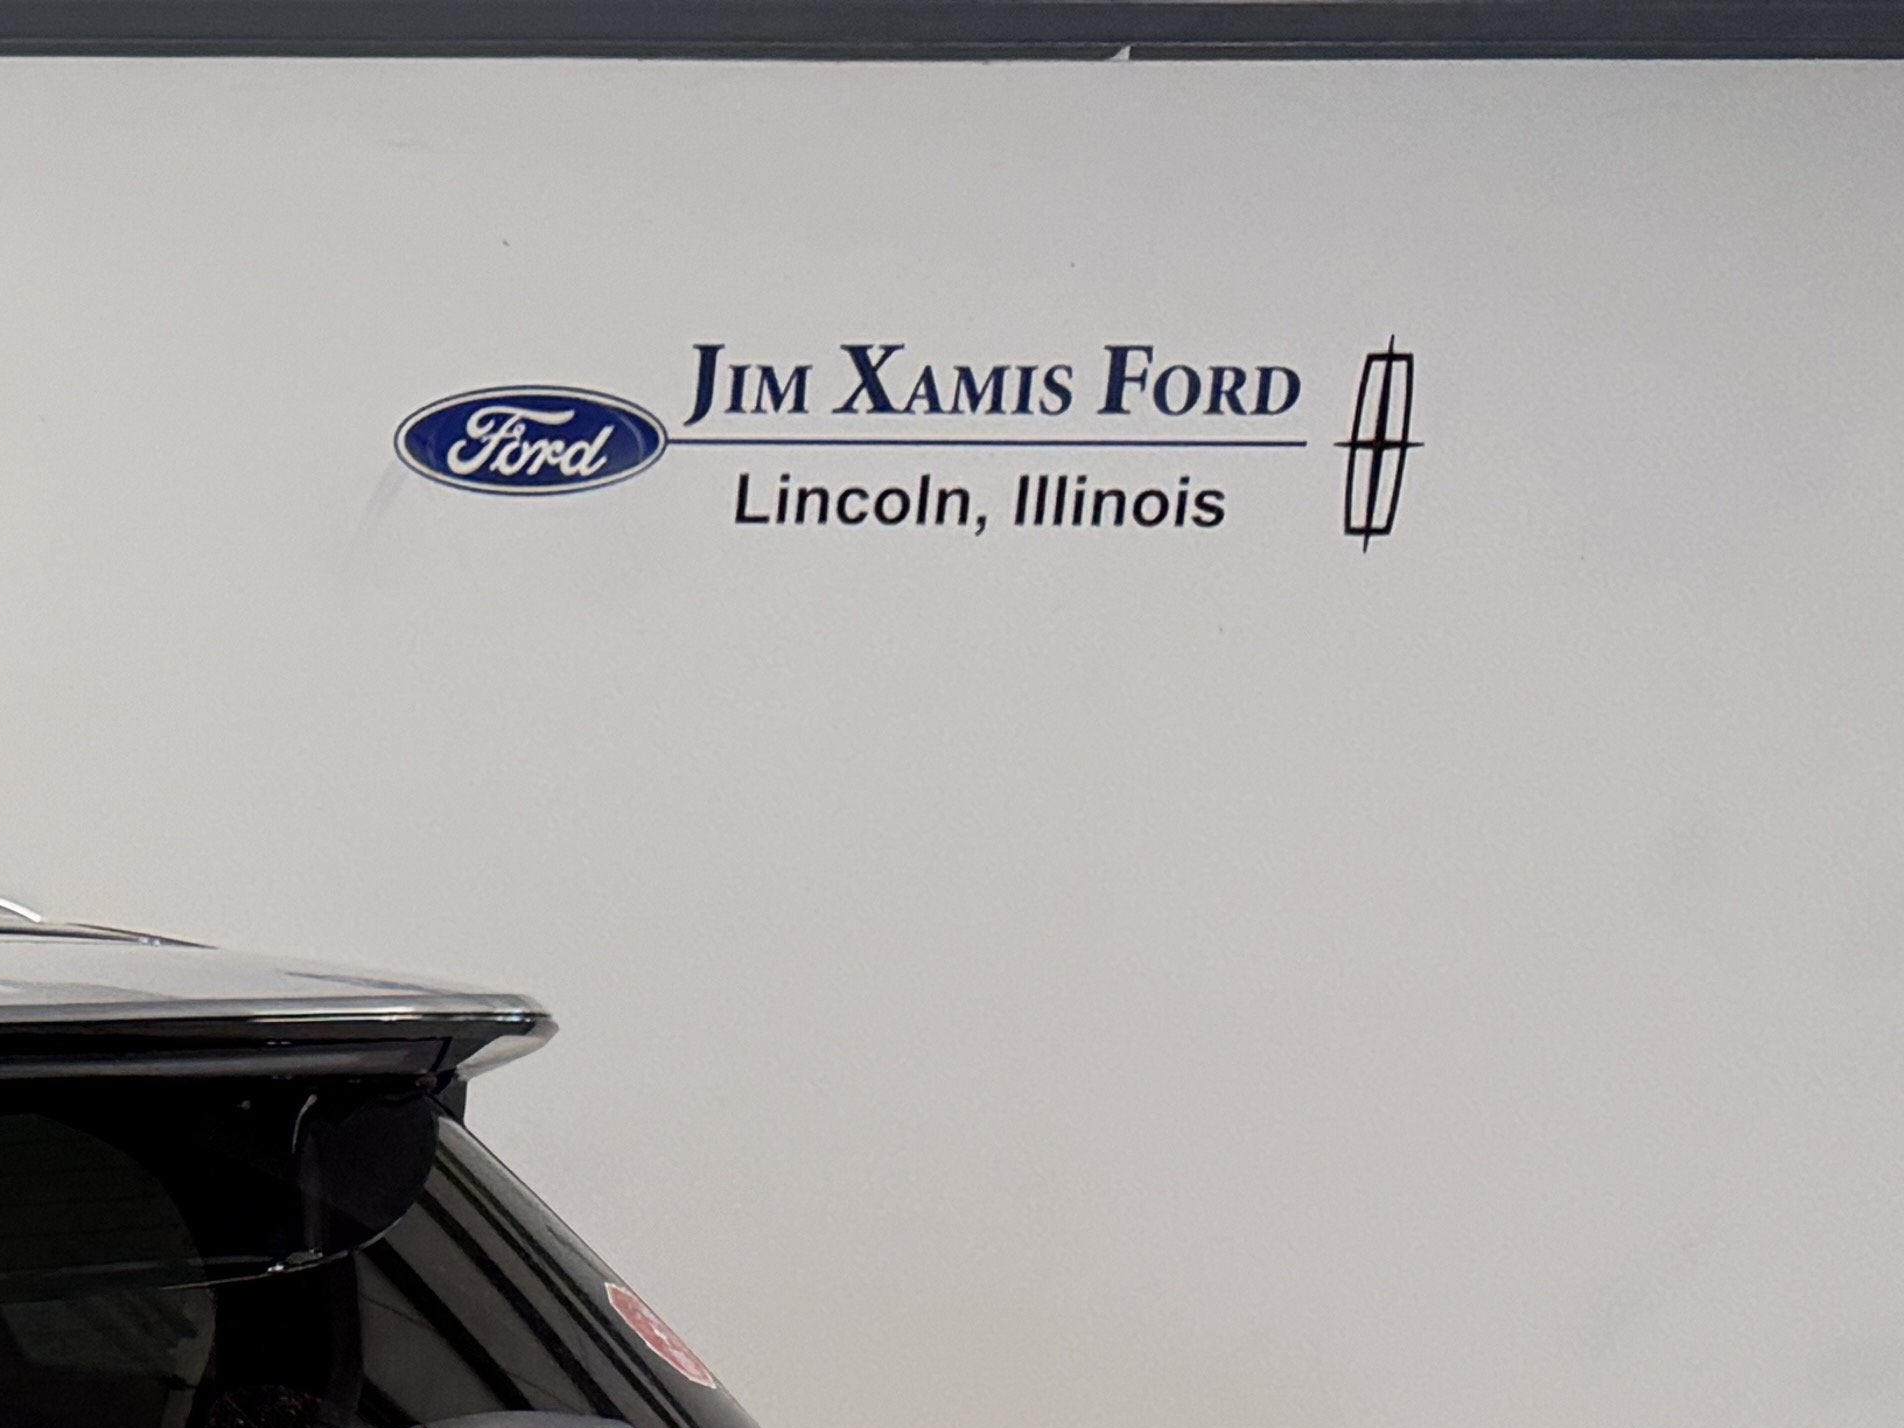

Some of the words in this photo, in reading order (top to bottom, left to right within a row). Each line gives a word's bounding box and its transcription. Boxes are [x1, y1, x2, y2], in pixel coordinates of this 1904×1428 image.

[682, 344, 812, 427] JIM
[831, 343, 1073, 416] XAMIS
[1097, 344, 1302, 416] FORD
[446, 405, 614, 477] Ford
[734, 473, 987, 536] Lincoln,
[1013, 474, 1226, 528] Illinois
